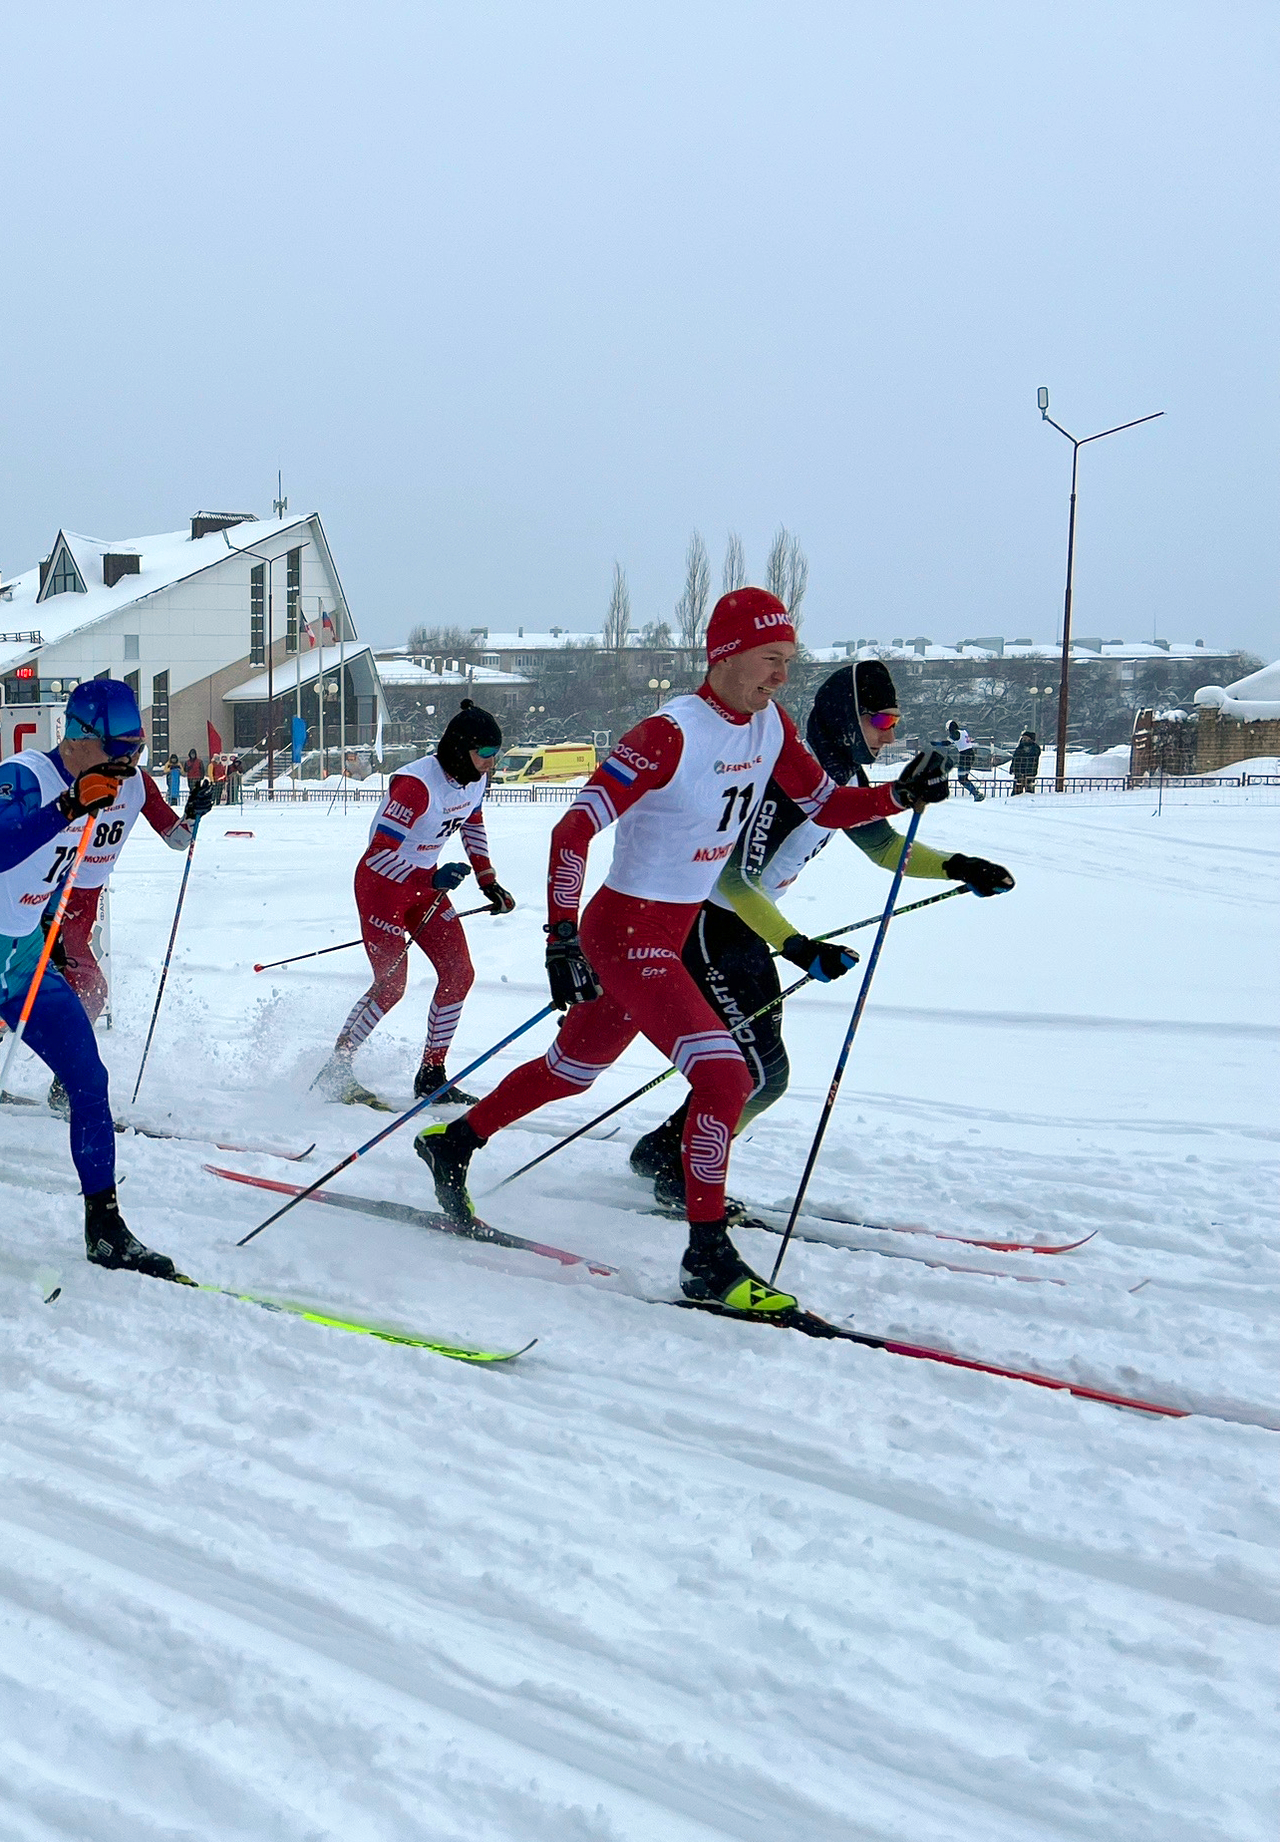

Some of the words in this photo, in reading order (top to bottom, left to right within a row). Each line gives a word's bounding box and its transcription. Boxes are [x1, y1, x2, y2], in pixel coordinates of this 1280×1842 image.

[385, 800, 414, 823] RUS
[747, 800, 778, 868] CRAFT
[710, 985, 757, 1044] CRAFT
